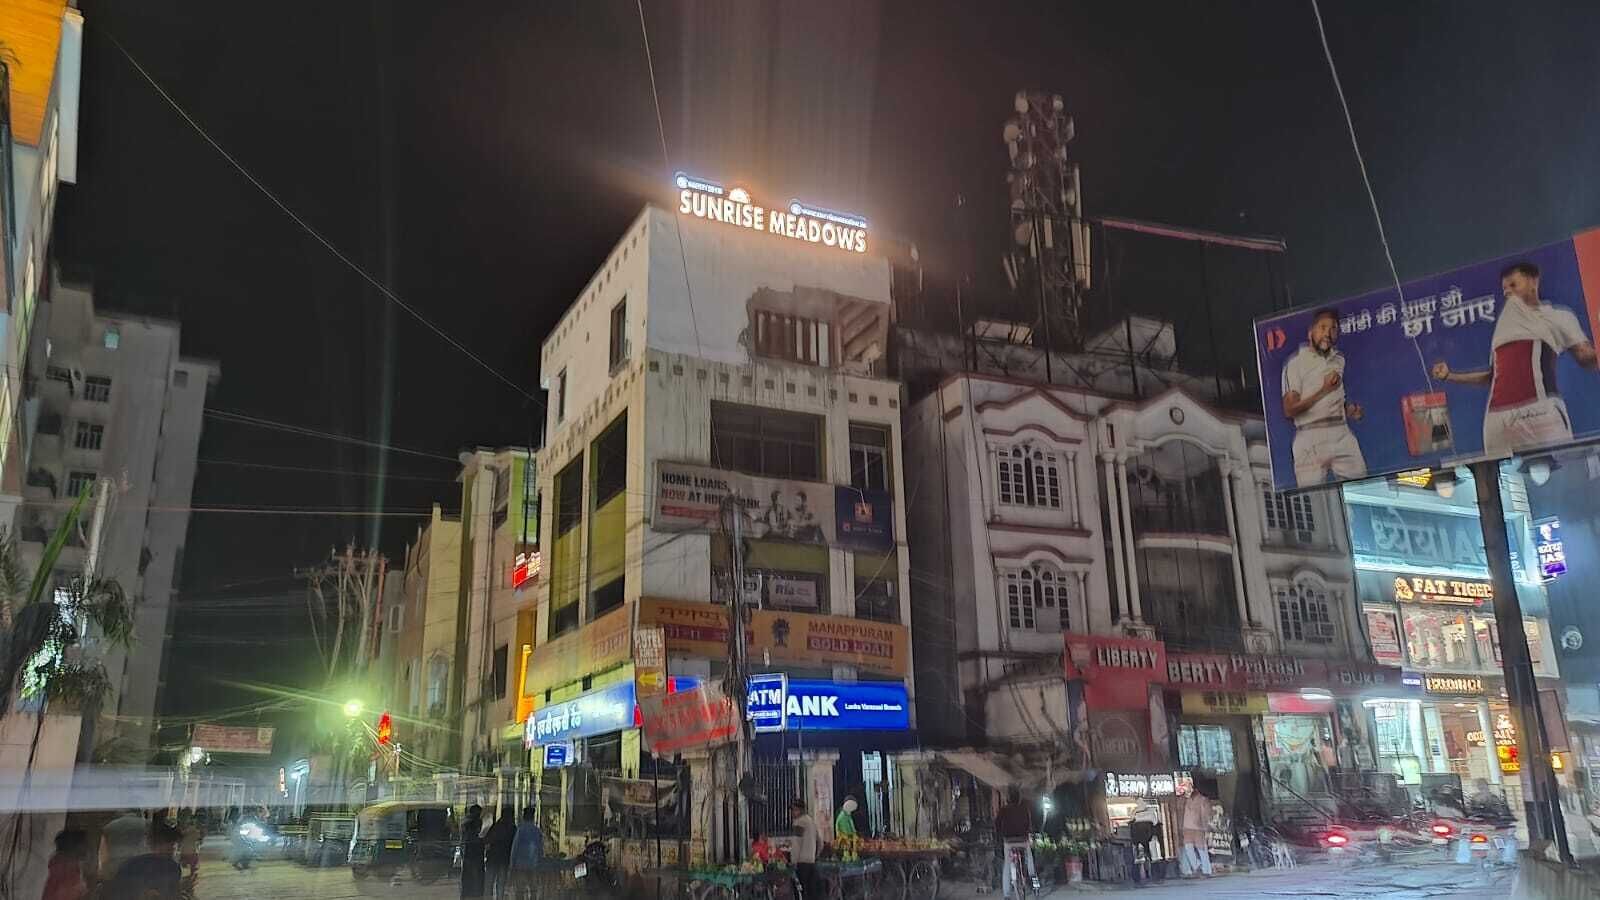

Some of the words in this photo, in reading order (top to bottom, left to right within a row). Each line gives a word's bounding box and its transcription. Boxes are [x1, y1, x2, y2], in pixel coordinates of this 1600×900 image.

[679, 189, 764, 231] SUNRISE
[769, 210, 867, 252] MEADOWS
[1376, 302, 1397, 325] की
[662, 472, 691, 487] HOME
[662, 488, 687, 501] NOW
[688, 490, 702, 502] AT
[1439, 527, 1488, 565] IA
[1412, 577, 1447, 595] FAT
[808, 619, 893, 642] MANAPPURAM
[811, 637, 849, 652] GOLD
[853, 640, 892, 657] LOAN
[1097, 646, 1158, 670] LIBERTY
[1168, 659, 1228, 684] BERTY
[1341, 671, 1385, 685] DUKE
[750, 688, 781, 705] ATM
[786, 695, 839, 717] ANK
